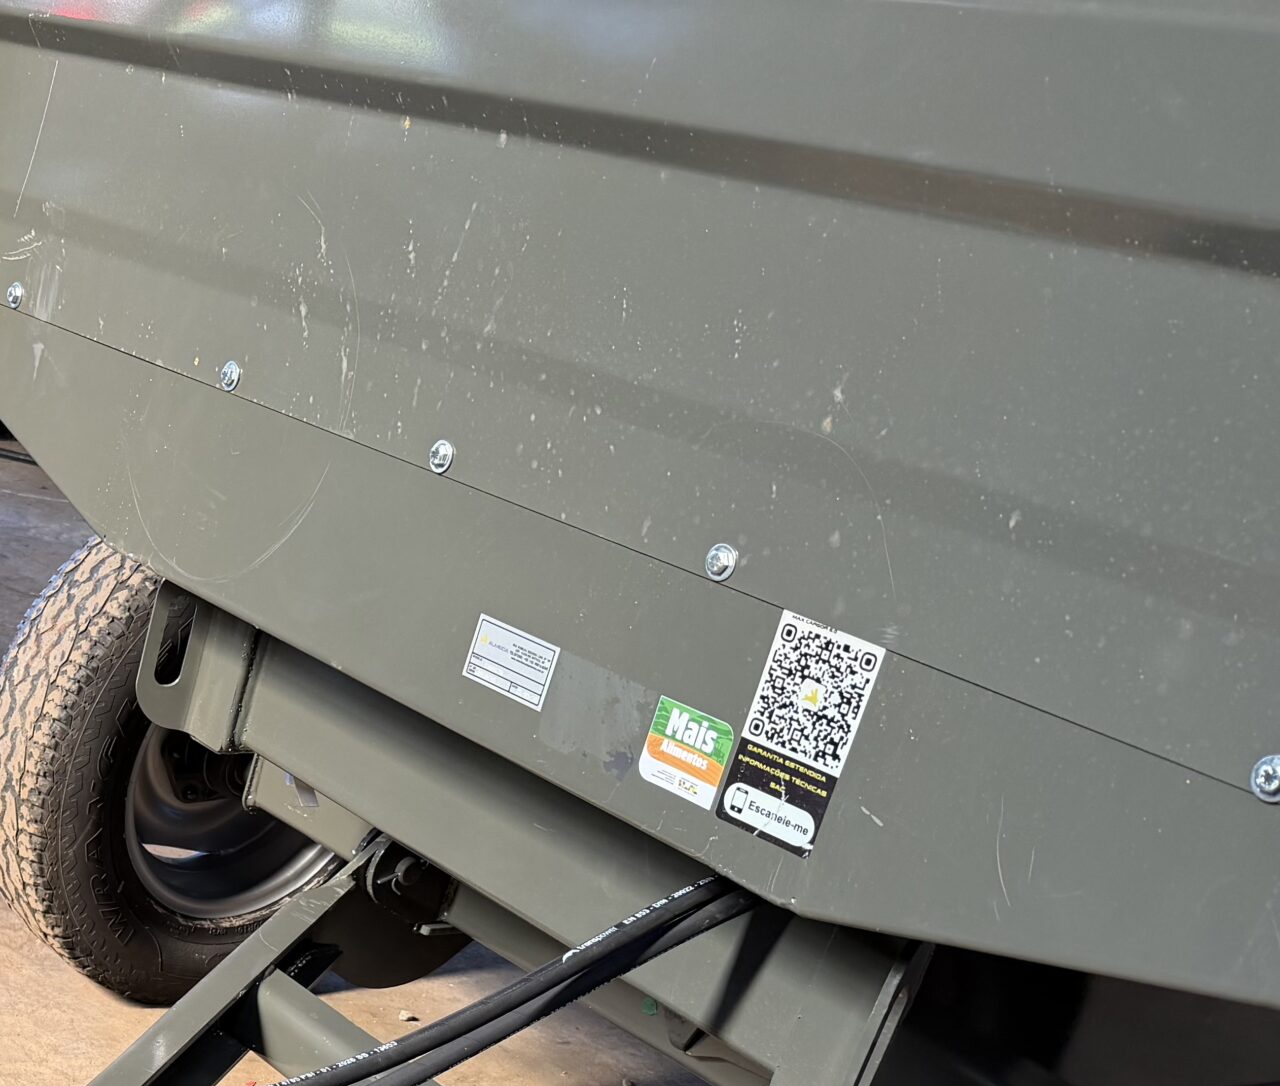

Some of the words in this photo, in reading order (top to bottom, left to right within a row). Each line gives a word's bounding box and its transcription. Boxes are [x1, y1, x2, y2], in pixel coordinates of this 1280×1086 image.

[665, 707, 718, 753] Mais
[660, 738, 709, 770] Alimentos
[738, 754, 790, 781] INFORMAÇÕES
[747, 744, 783, 764] GARANTIA
[785, 760, 826, 782] ESTENDIDA
[770, 781, 786, 792] SAC
[748, 800, 809, 836] Escaneie-me
